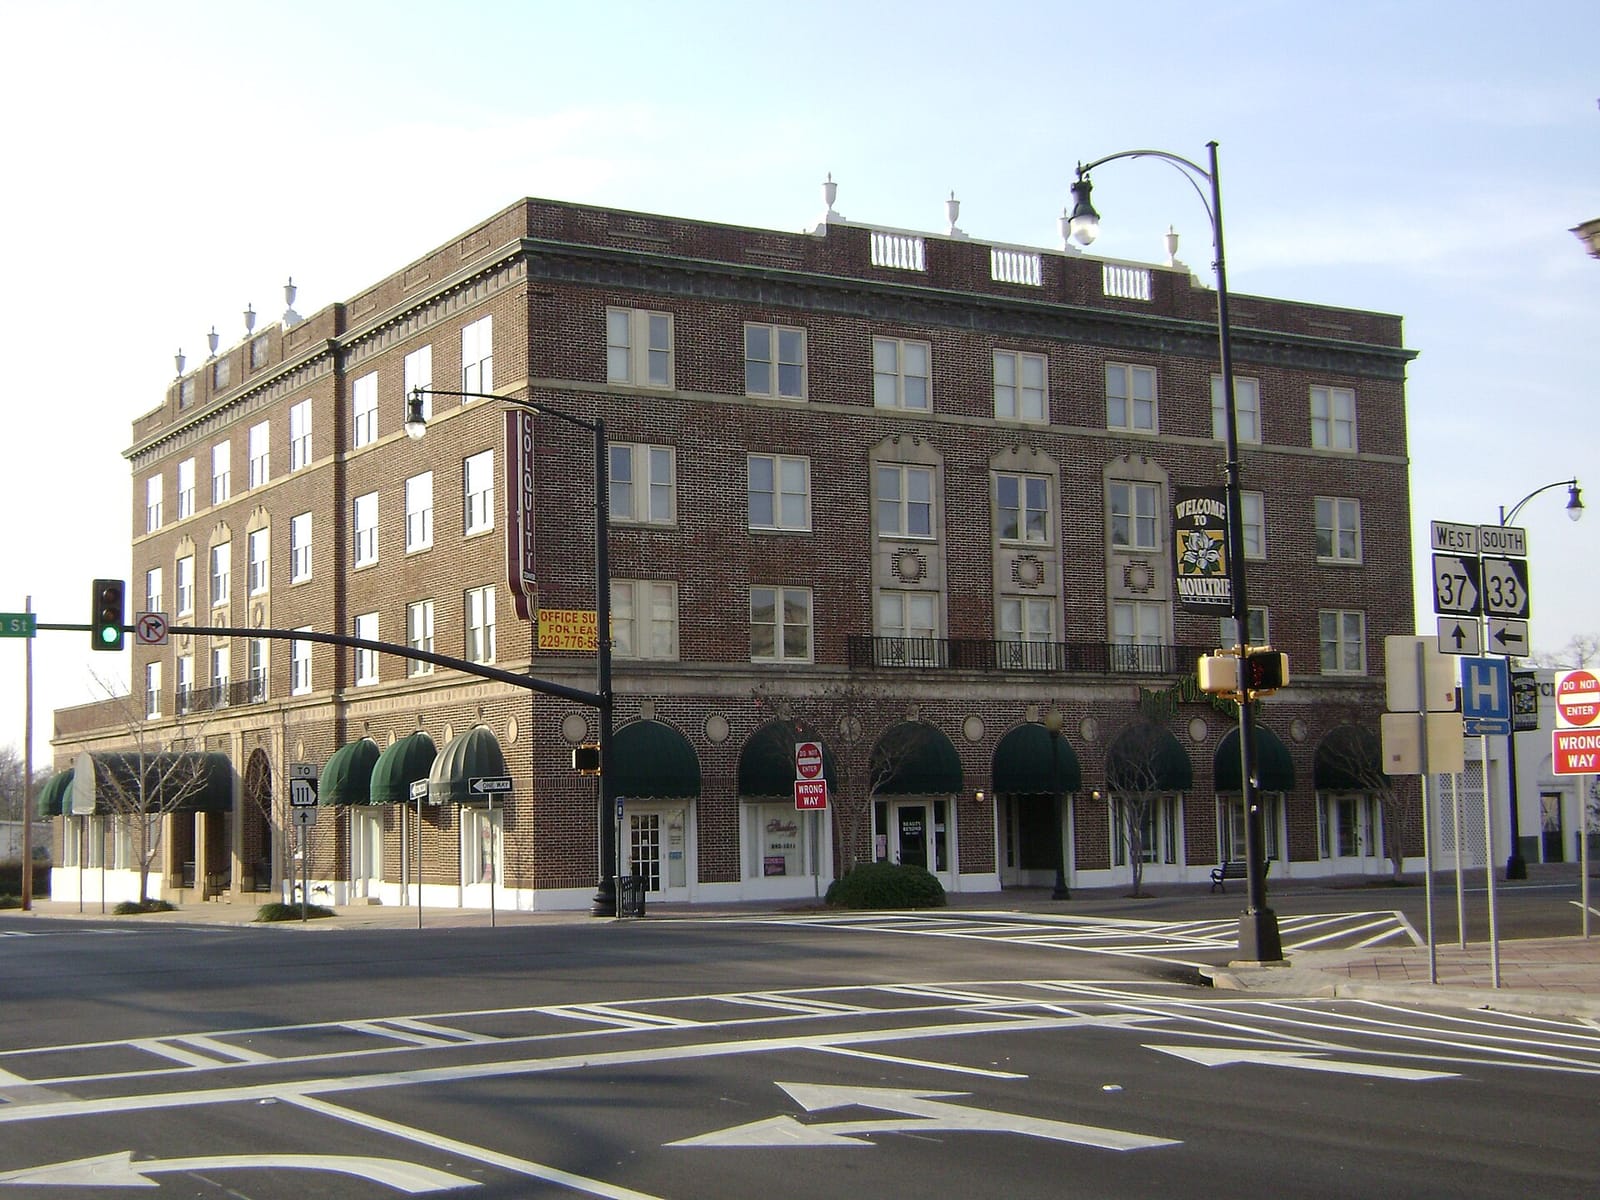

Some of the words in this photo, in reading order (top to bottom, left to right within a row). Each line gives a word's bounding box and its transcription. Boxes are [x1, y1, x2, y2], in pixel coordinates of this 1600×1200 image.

[523, 415, 534, 570] COLQUITT
[1176, 499, 1226, 520] WELCOME
[1194, 515, 1207, 526] TO
[1436, 526, 1472, 549] WEST
[1483, 531, 1523, 550] SOUTH
[1177, 578, 1231, 596] MOULTRIE
[1440, 573, 1467, 606] 37
[1490, 575, 1517, 608] 33
[540, 611, 578, 623] OFFICE
[11, 619, 27, 631] St
[548, 624, 570, 634] FOR
[573, 626, 598, 635] LEAS
[540, 635, 598, 649] 229-776-5
[1471, 665, 1499, 711] H
[1563, 681, 1575, 691] DO
[1580, 679, 1596, 690] NOT
[1567, 705, 1594, 716] ENTER
[1559, 735, 1600, 750] WRONG
[1568, 754, 1595, 768] WAY
[297, 766, 310, 775] TO
[297, 787, 309, 802] 111
[798, 784, 823, 794] WRONG
[803, 796, 818, 806] WAY
